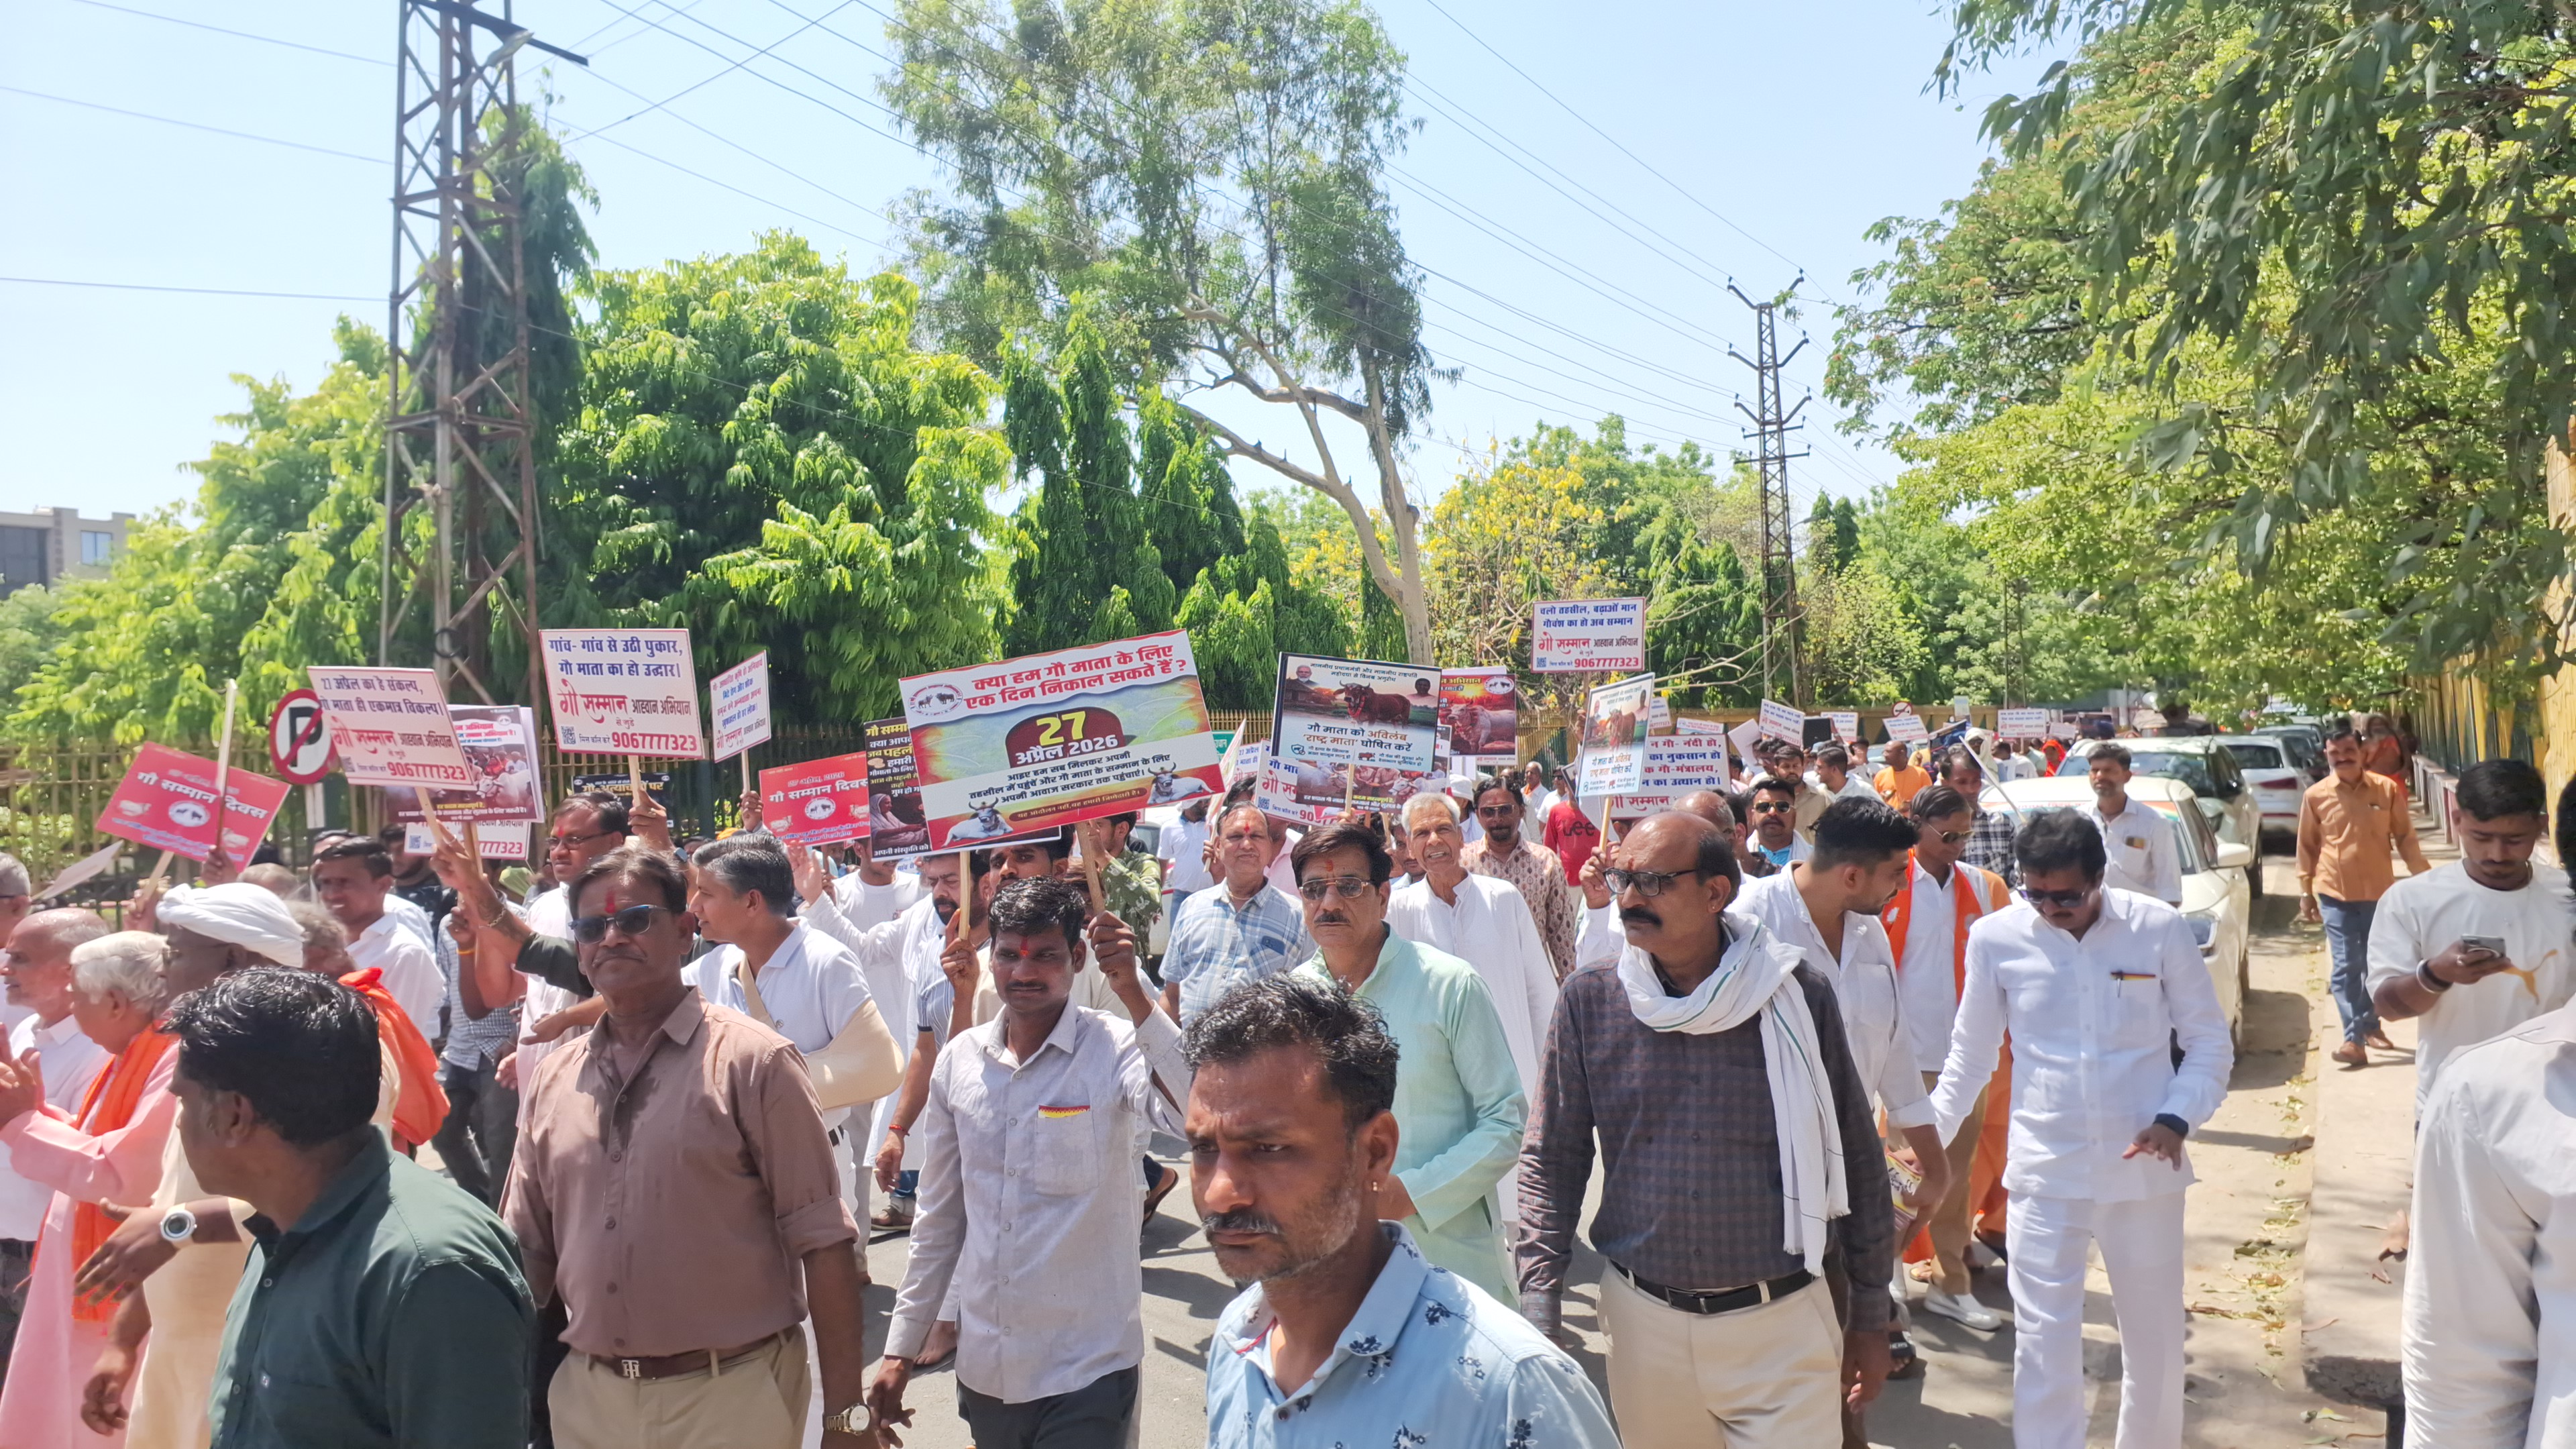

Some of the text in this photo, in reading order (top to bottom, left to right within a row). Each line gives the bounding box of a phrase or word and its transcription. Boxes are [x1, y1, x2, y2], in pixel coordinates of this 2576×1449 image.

[1559, 604, 1590, 614] तहसील,
[1621, 604, 1637, 612] मान
[1543, 619, 1564, 628] गौवंश
[1580, 617, 1588, 627] हो
[1591, 619, 1604, 627] अब
[1607, 617, 1633, 625] सम्मान
[580, 637, 603, 653] गांव
[606, 636, 618, 652] से
[621, 636, 641, 653] उठी
[645, 639, 683, 657] पुकार,
[1556, 639, 1591, 654] सम्मान
[1615, 636, 1638, 647] अभियान
[558, 659, 573, 676] गौ
[576, 663, 604, 676] माता
[606, 663, 623, 676] का
[626, 660, 639, 676] हो
[972, 644, 1174, 691] क्या हम गौ माता के लिए
[1574, 657, 1639, 667] 9067777323
[361, 678, 376, 690] का
[963, 694, 996, 710] एक
[999, 686, 1035, 704] दिन
[1038, 673, 1104, 698] निकाल
[1107, 663, 1155, 684] सकते
[1156, 656, 1175, 676] हैं
[367, 700, 404, 714] एकमात्र
[580, 694, 629, 724] सम्मान
[659, 696, 692, 715] अभियान
[289, 707, 323, 767] P
[865, 723, 909, 737] गौ सम्मा
[1036, 710, 1086, 747] 27
[1307, 722, 1407, 741] गौ माता को अविलंब
[612, 732, 697, 751] 9067777323
[869, 739, 887, 749] क्या
[1015, 735, 1118, 765] अप्रैल 2026
[1360, 739, 1393, 751] घोषित
[1394, 742, 1413, 752] करें
[1683, 738, 1702, 747] नंदी
[1707, 738, 1721, 748] हो,
[887, 755, 912, 767] हमारी
[1269, 759, 1281, 769] गौ
[1666, 752, 1707, 763] नुकसान
[1710, 750, 1721, 759] हो
[387, 761, 466, 780] 9067777323
[1007, 751, 1131, 782] आइए हम सब मिलकर अपनी
[969, 786, 1004, 800] तहसील
[1005, 781, 1016, 792] में
[1039, 771, 1057, 786] और
[1058, 769, 1070, 781] गौ
[1071, 767, 1093, 780] माता
[1094, 763, 1104, 775] के
[1105, 759, 1140, 773] सम्मान
[1140, 755, 1151, 766] के
[1152, 753, 1171, 766] लिए
[1670, 777, 1702, 786] उत्थान
[161, 780, 218, 803] सम्मान
[769, 791, 784, 803] गौ
[788, 784, 832, 800] सम्मान
[1001, 790, 1028, 804] अपनी
[1029, 786, 1059, 798] आवाज
[1061, 780, 1094, 792] सरकार
[1095, 776, 1111, 786] तक
[1627, 796, 1670, 811] सम्मान
[1562, 820, 1595, 837] Lee
[874, 847, 893, 856] अपनी
